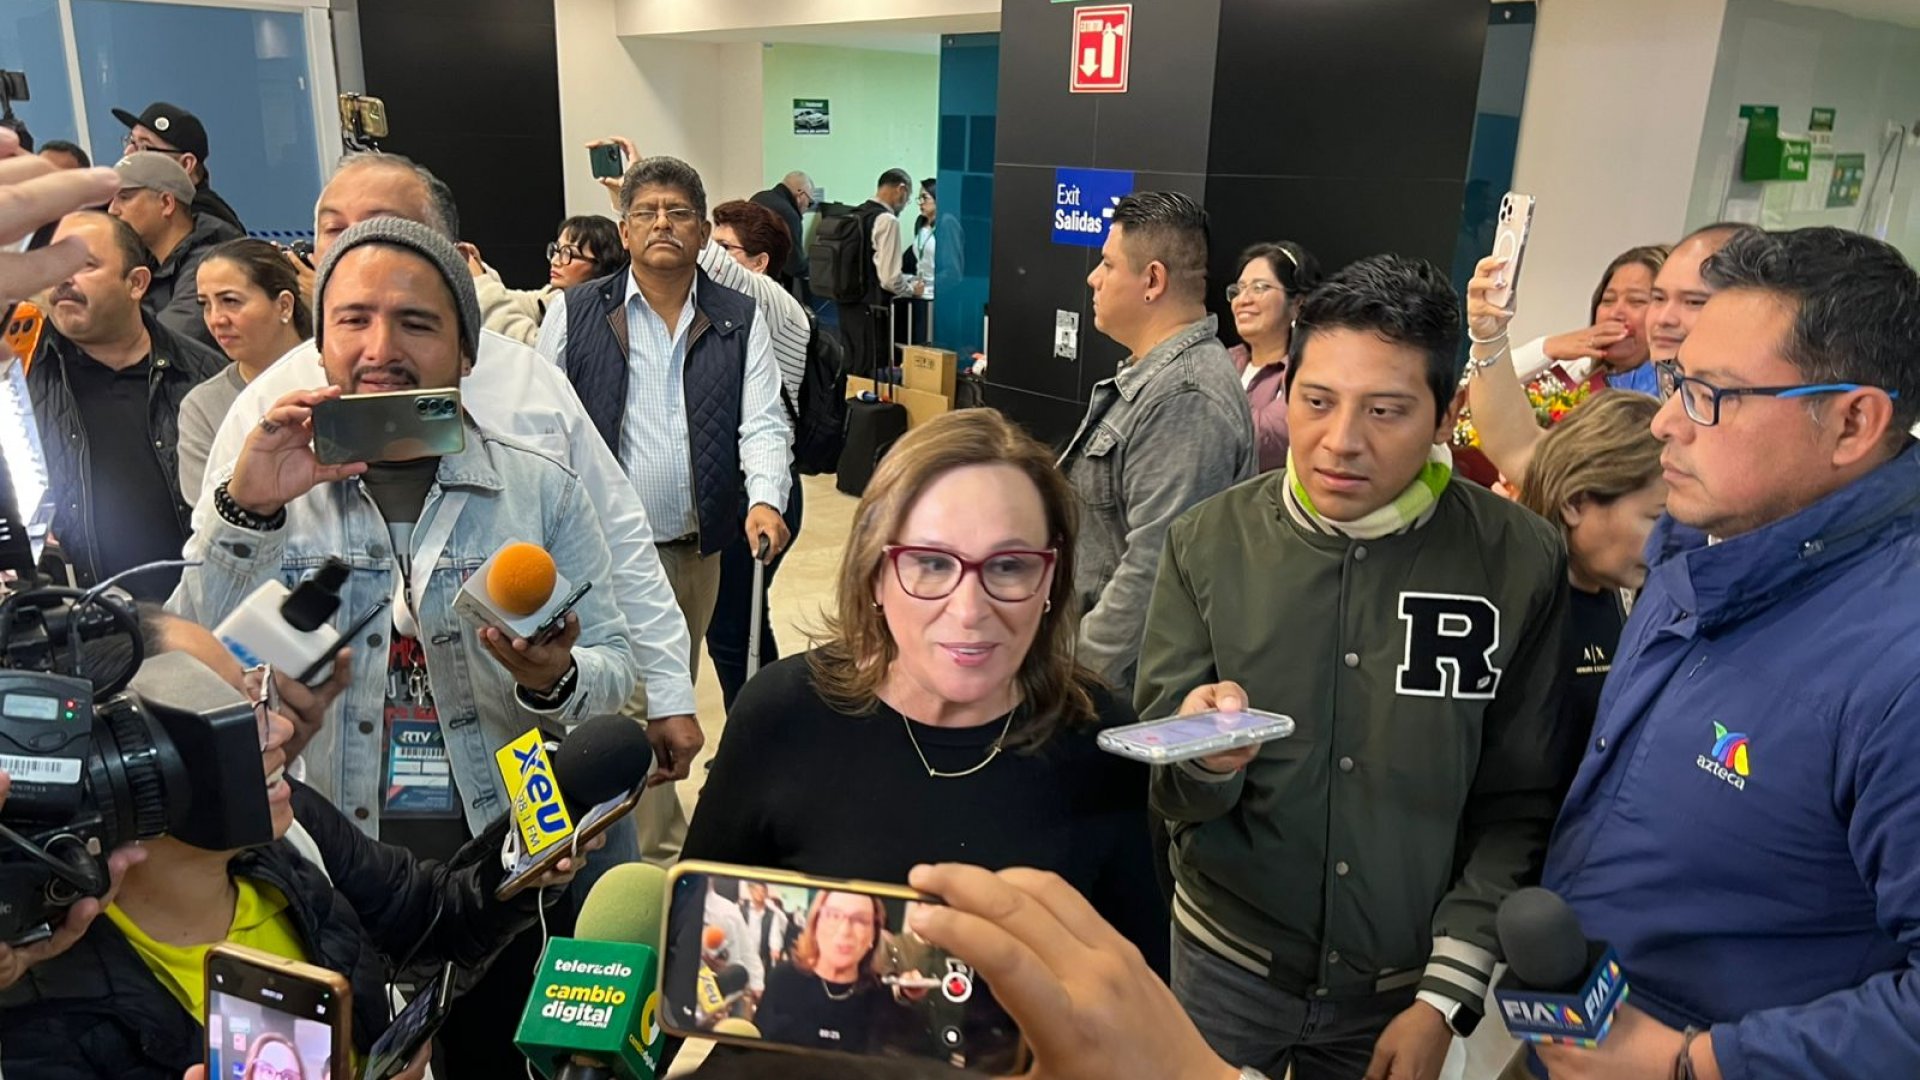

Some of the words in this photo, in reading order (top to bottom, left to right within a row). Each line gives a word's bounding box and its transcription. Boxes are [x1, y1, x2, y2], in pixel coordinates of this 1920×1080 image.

[1056, 183, 1080, 206] Exit
[1054, 208, 1103, 234] Salidas
[1395, 591, 1503, 699] R
[401, 730, 431, 744] RTV
[1696, 754, 1746, 791] azteca
[526, 825, 541, 848] FM
[545, 984, 626, 1005] cambio
[541, 1000, 614, 1023] digital
